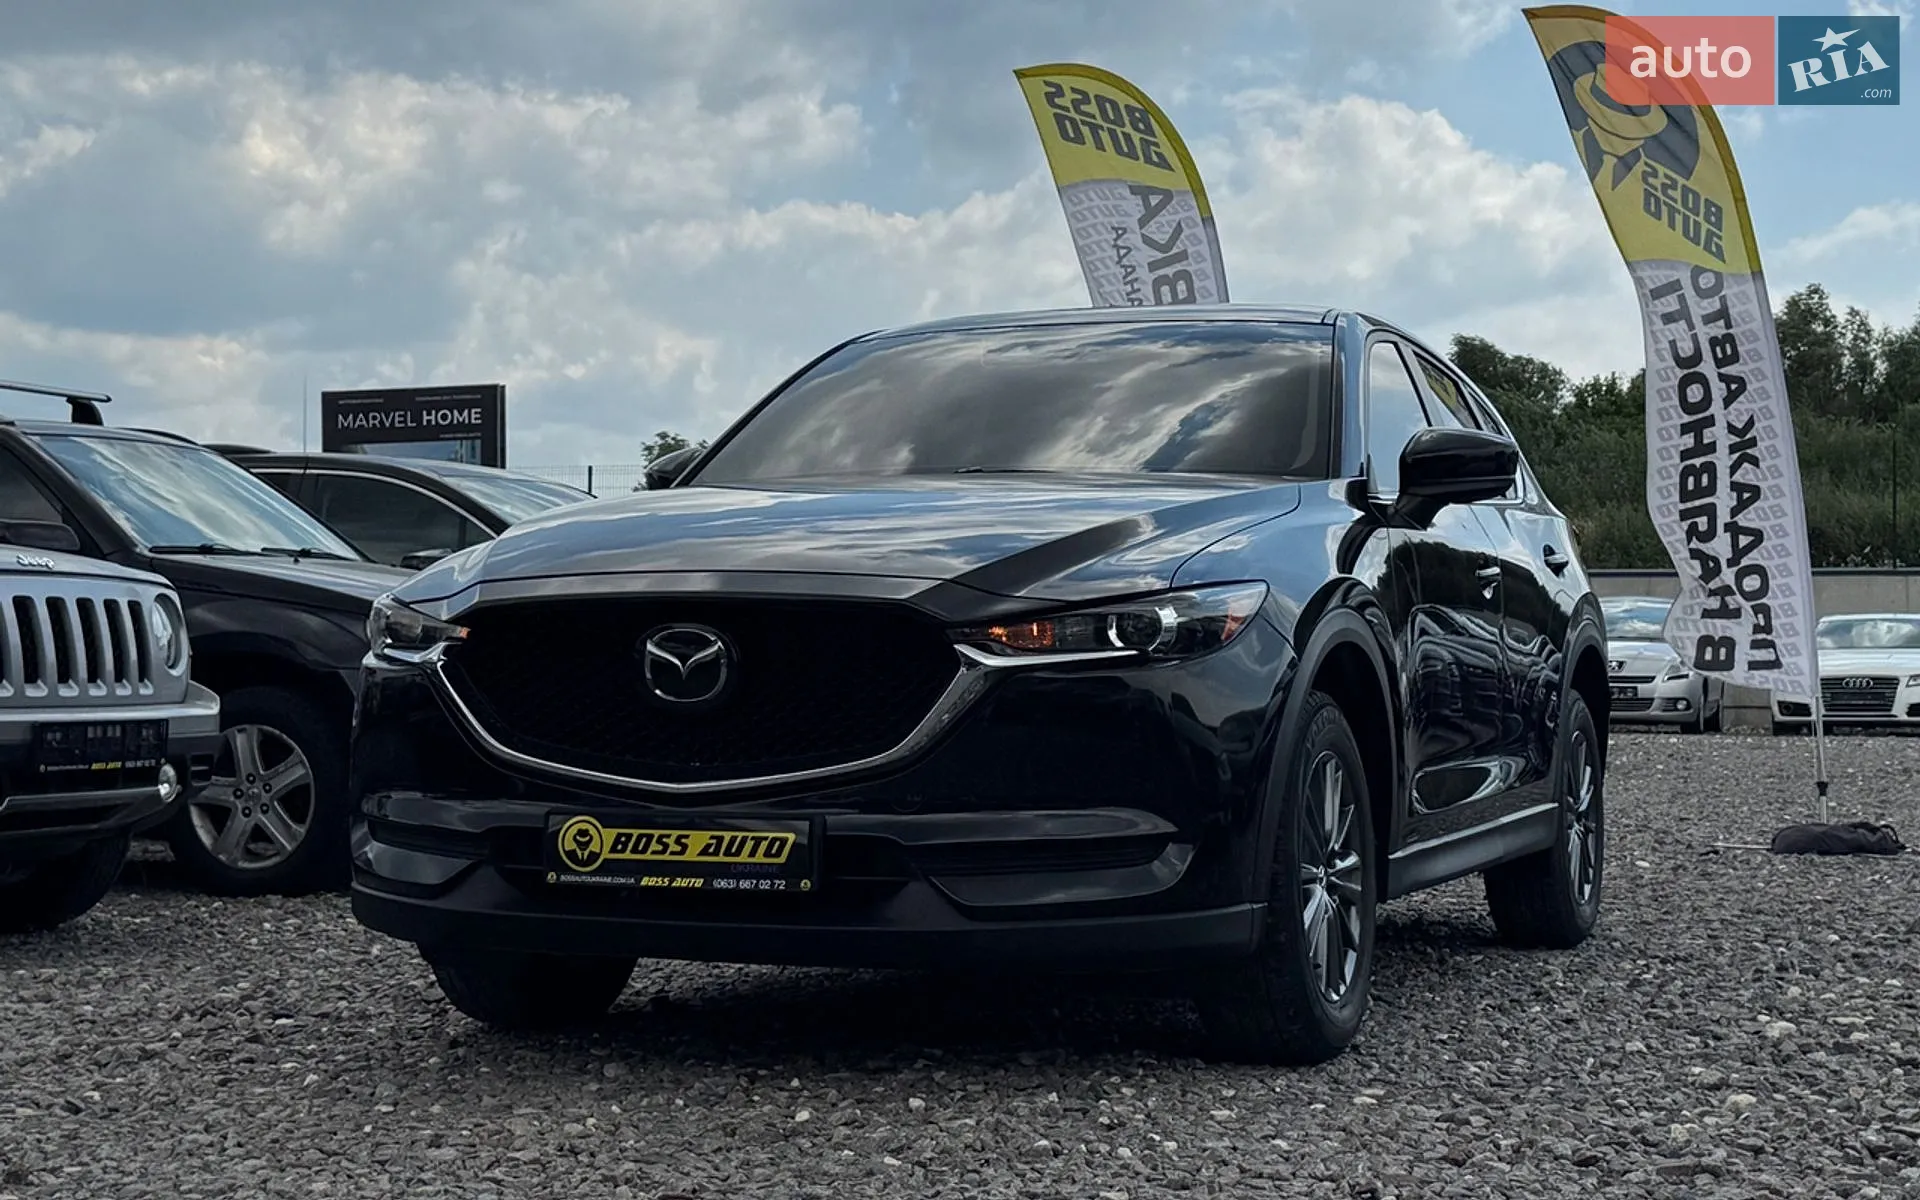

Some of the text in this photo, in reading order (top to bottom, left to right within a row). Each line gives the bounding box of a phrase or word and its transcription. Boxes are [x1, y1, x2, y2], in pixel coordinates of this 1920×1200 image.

[337, 408, 482, 429] MARVEL HOME
[608, 832, 790, 858] BOSS AUTO
[640, 876, 669, 886] BOSS
[671, 878, 704, 887] AUTO
[759, 880, 771, 889] 02
[773, 880, 786, 889] 72
